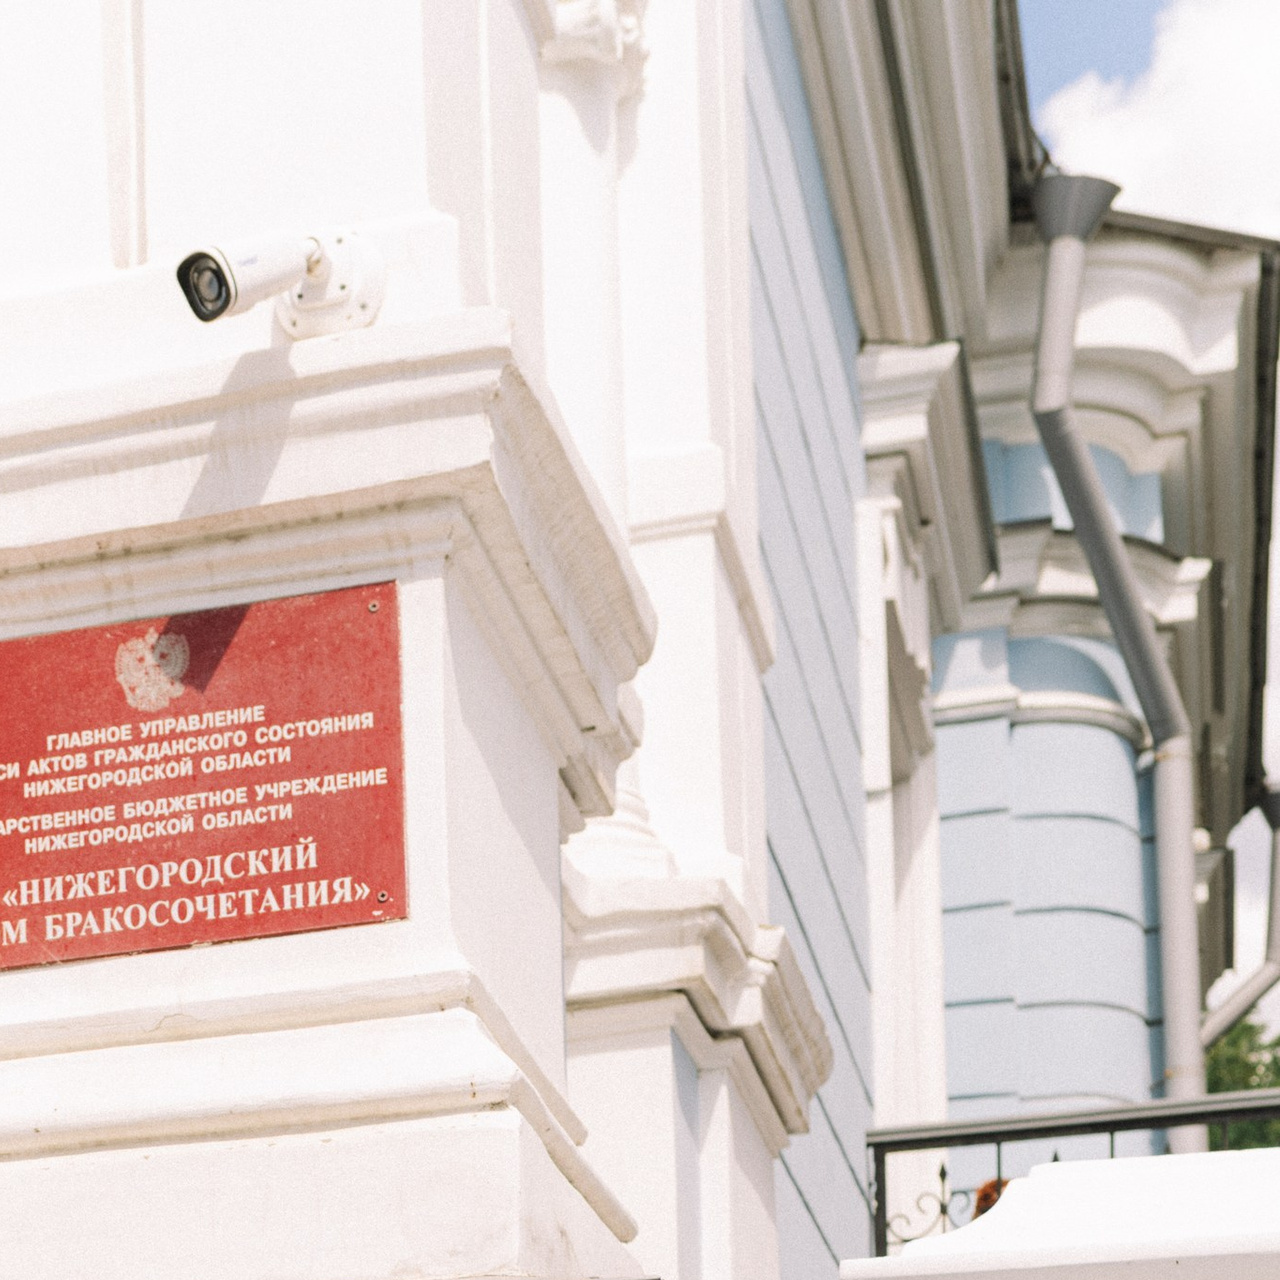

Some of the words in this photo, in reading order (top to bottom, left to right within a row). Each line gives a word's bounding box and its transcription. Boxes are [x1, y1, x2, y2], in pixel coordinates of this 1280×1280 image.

[28, 752, 87, 774] АКТОВ
[94, 729, 247, 767] ГРАЖДАНСКОГО
[254, 712, 373, 741] СОСТОЯНИЯ
[46, 724, 132, 751] ГЛАВНОЕ
[140, 705, 265, 736] УПРАВЛЕНИЕ
[24, 758, 193, 798] НИЖЕГОРОДСКОЙ
[201, 746, 291, 774] ОБЛАСТИ
[124, 788, 247, 820] БЮДЖЕТНОЕ
[254, 768, 388, 801] УЧРЕЖДЕНИЕ
[25, 814, 194, 854] НИЖЕГОРОДСКОЙ
[202, 803, 292, 831] ОБЛАСТИ
[3, 837, 318, 908] «НИЖЕГОРОДСКИЙ
[45, 876, 370, 941] БРАКОСОЧЕТАНИЯ»
